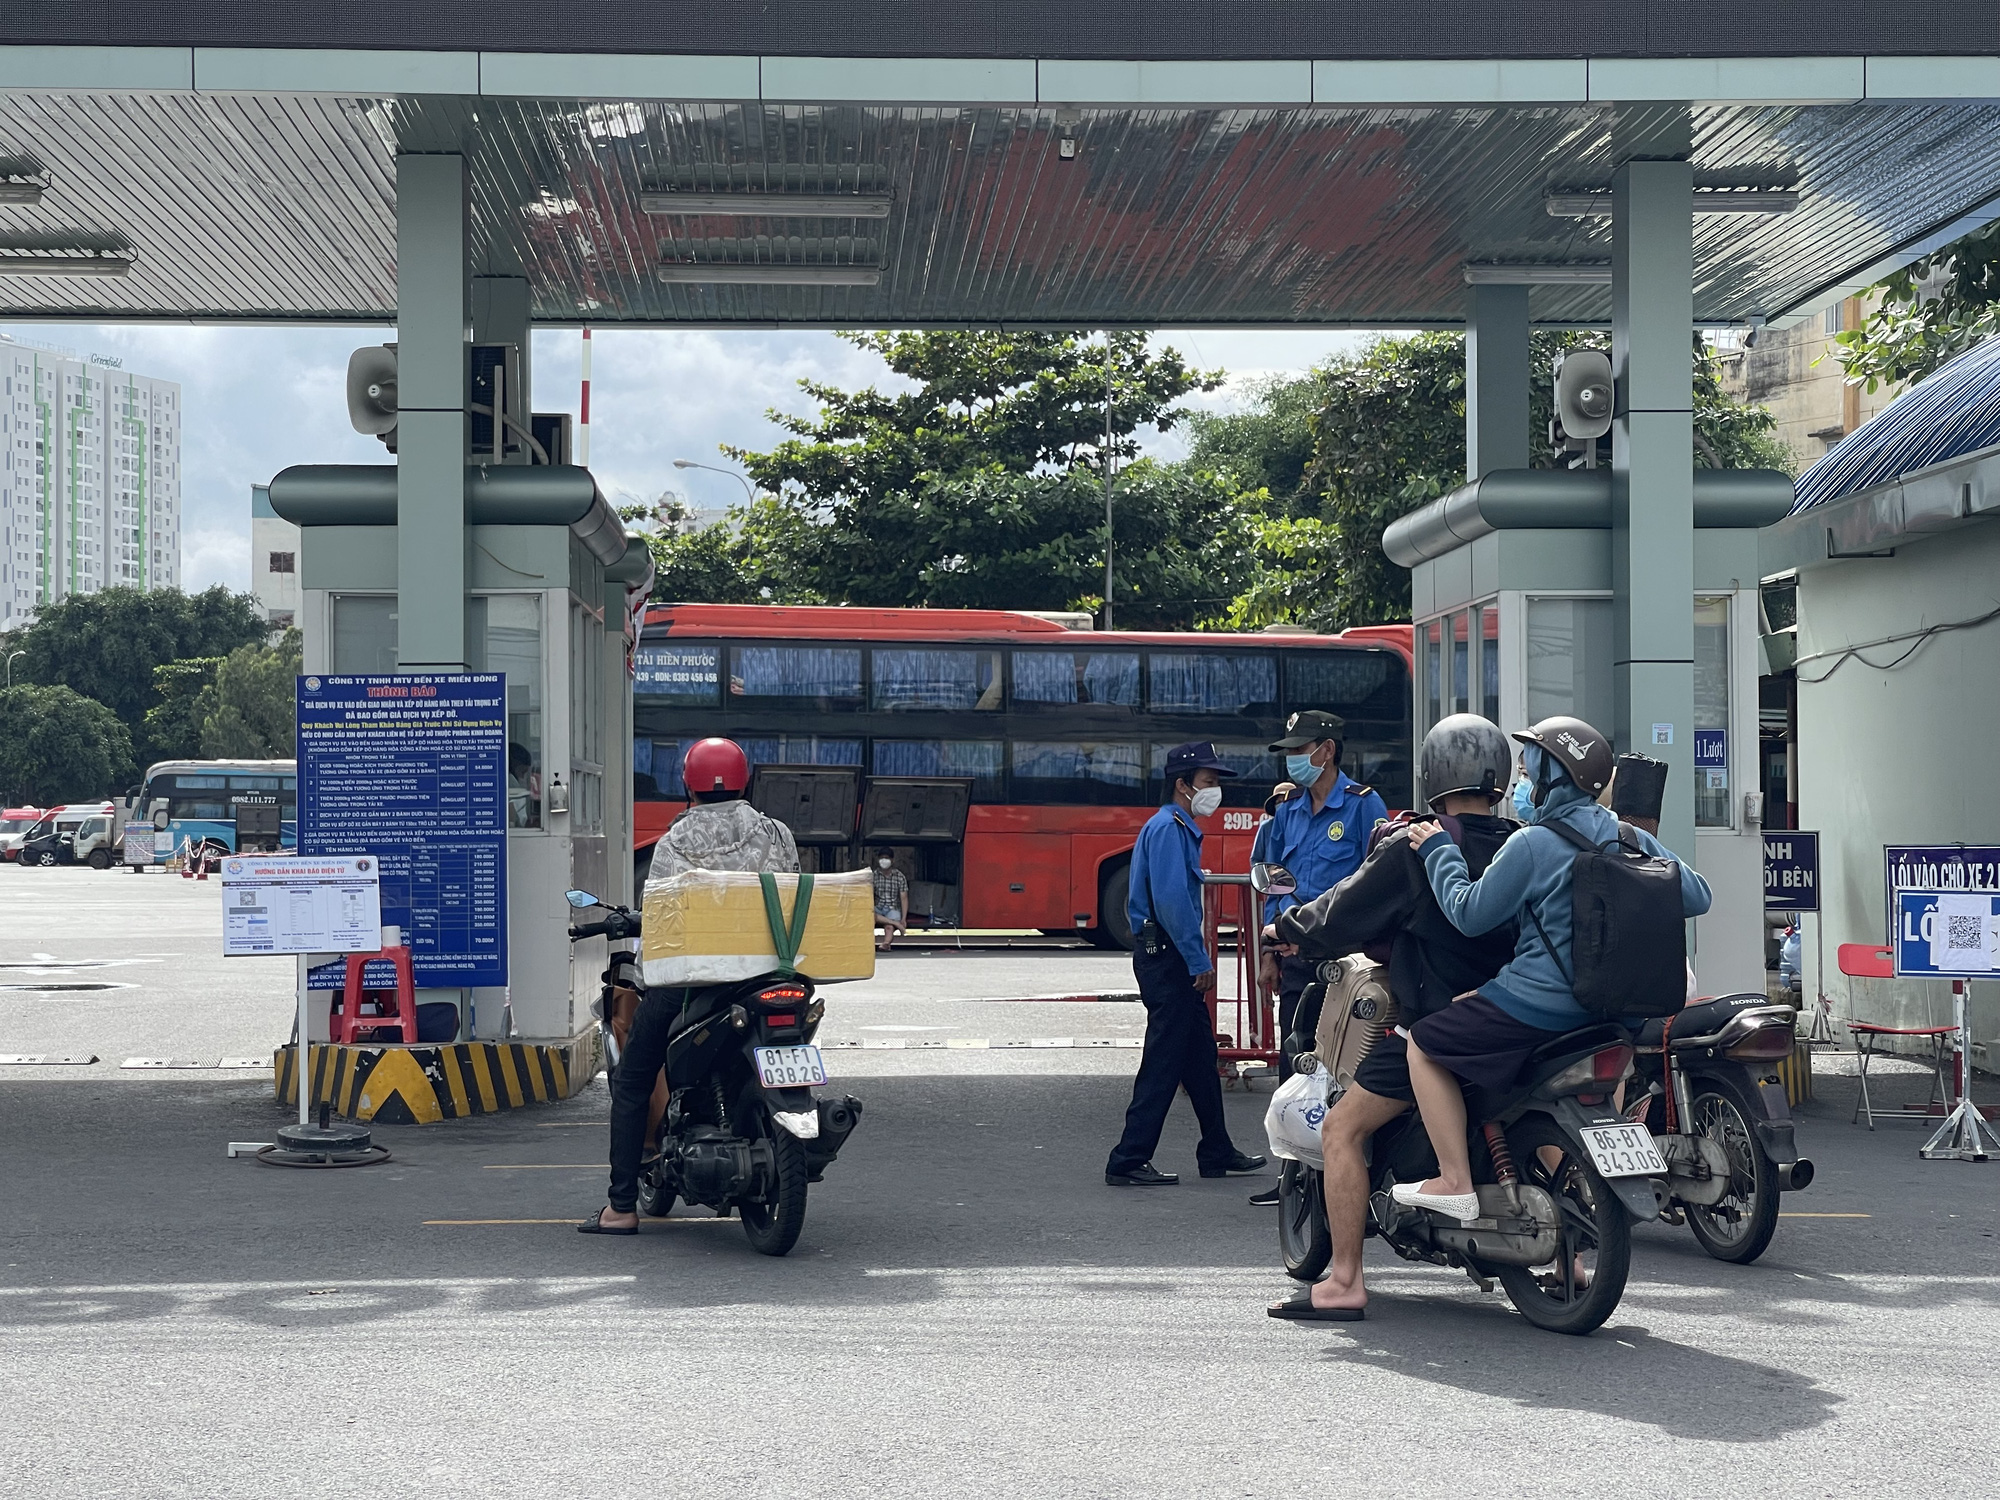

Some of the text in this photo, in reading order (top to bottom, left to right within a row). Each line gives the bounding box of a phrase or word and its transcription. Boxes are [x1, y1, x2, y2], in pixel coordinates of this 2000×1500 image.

[91, 353, 122, 368] Greenfield
[637, 651, 715, 666] TẢI HIỀN PHƯỚC
[414, 675, 432, 683] BẾN
[448, 675, 471, 683] MIỀN
[367, 684, 437, 697] THÔNG BÁO
[345, 711, 355, 719] ĐÃ
[372, 710, 388, 719] GỒM
[389, 710, 402, 718] GIÁ
[403, 711, 419, 720] DỊCH
[420, 711, 430, 719] VỤ
[431, 709, 445, 718] XẾP
[462, 720, 478, 728] Dụng
[494, 720, 502, 728] Vụ
[1563, 731, 1580, 747] PARIS
[1696, 739, 1723, 762] 1 Lượt
[1224, 812, 1274, 830] 29B-
[1764, 842, 1792, 860] NH
[321, 867, 335, 875] ĐIỆN
[1764, 863, 1813, 888] ỐI BÊN
[1892, 853, 1994, 888] LỐI VÀO CHO XE 2
[1729, 998, 1766, 1006] HONDA
[766, 1048, 810, 1065] 81-F1
[764, 1066, 821, 1085] 038.26
[1593, 1128, 1643, 1150] 86-B1
[1597, 1150, 1661, 1173] 343.06
